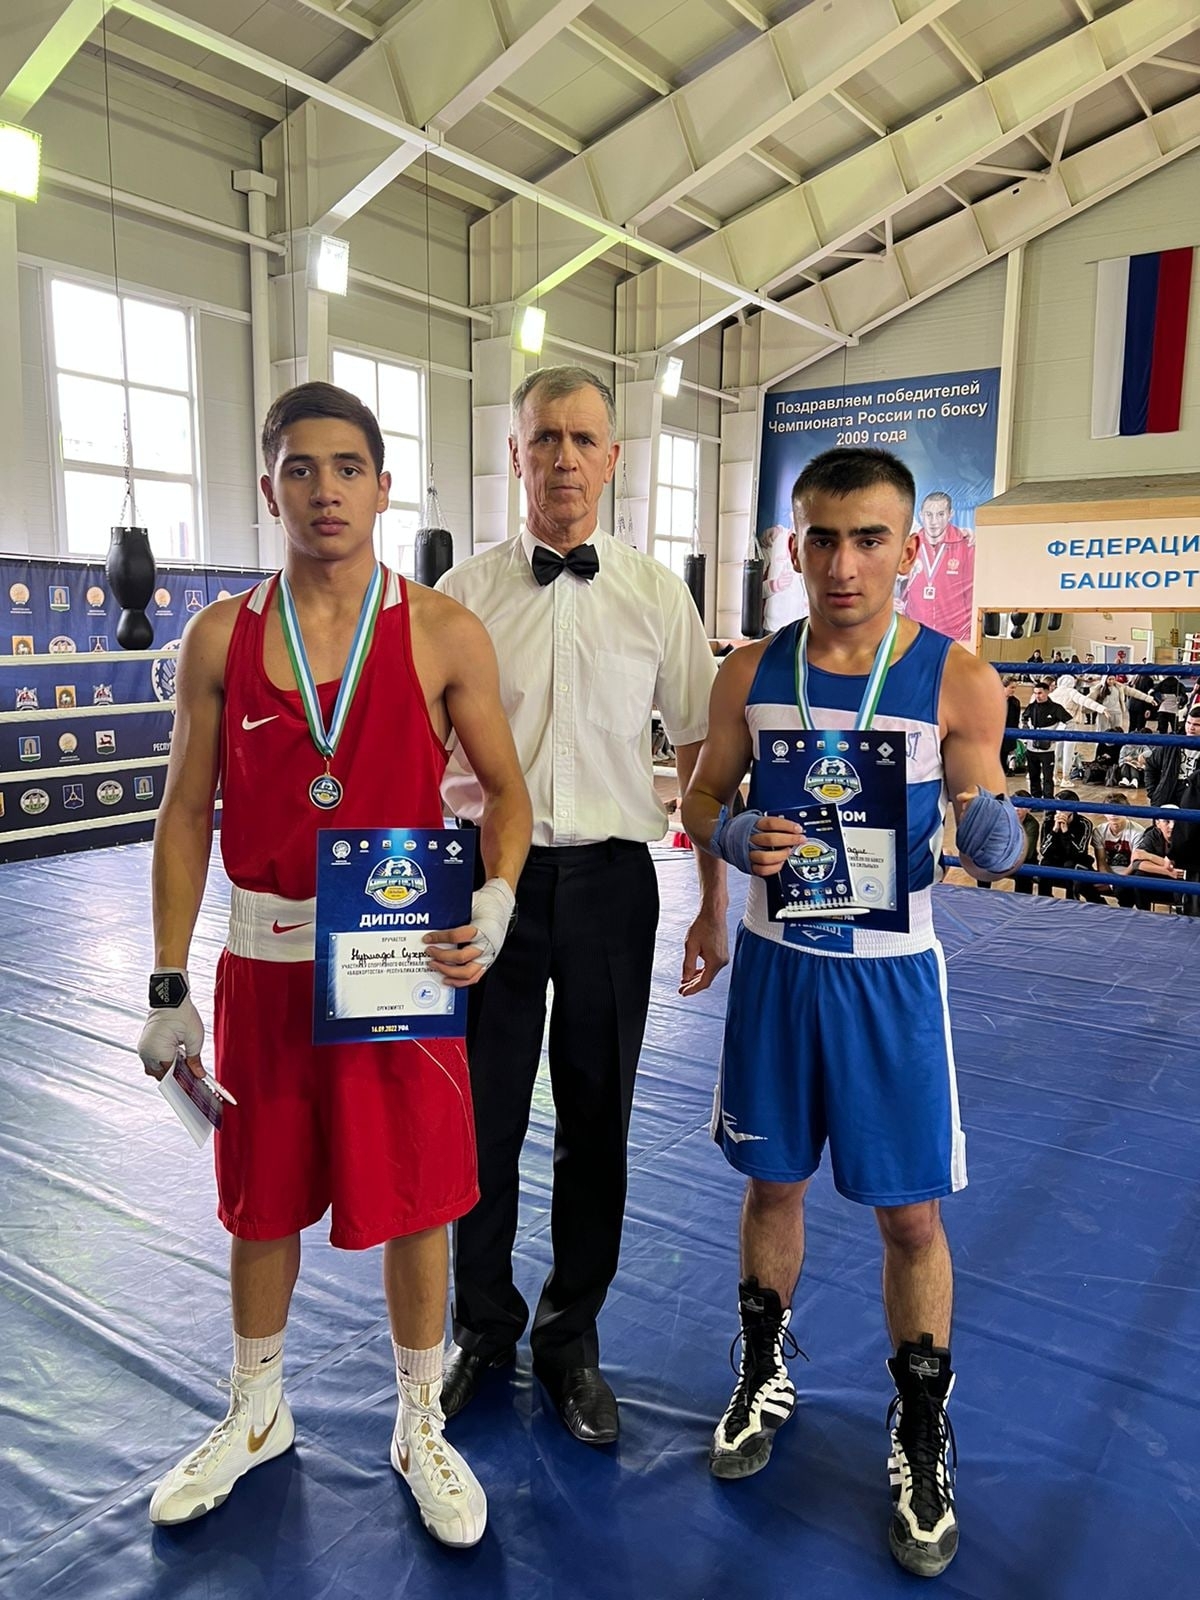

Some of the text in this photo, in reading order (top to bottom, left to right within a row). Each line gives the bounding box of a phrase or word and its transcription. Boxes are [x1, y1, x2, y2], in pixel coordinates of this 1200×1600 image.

[775, 381, 981, 415] Поздравляем победителей
[768, 401, 988, 433] Чемпионата России по боксу
[836, 429, 907, 446] 2009 года
[1060, 570, 1200, 589] БАШКОРТ
[359, 912, 430, 928] ДИПЛОМ
